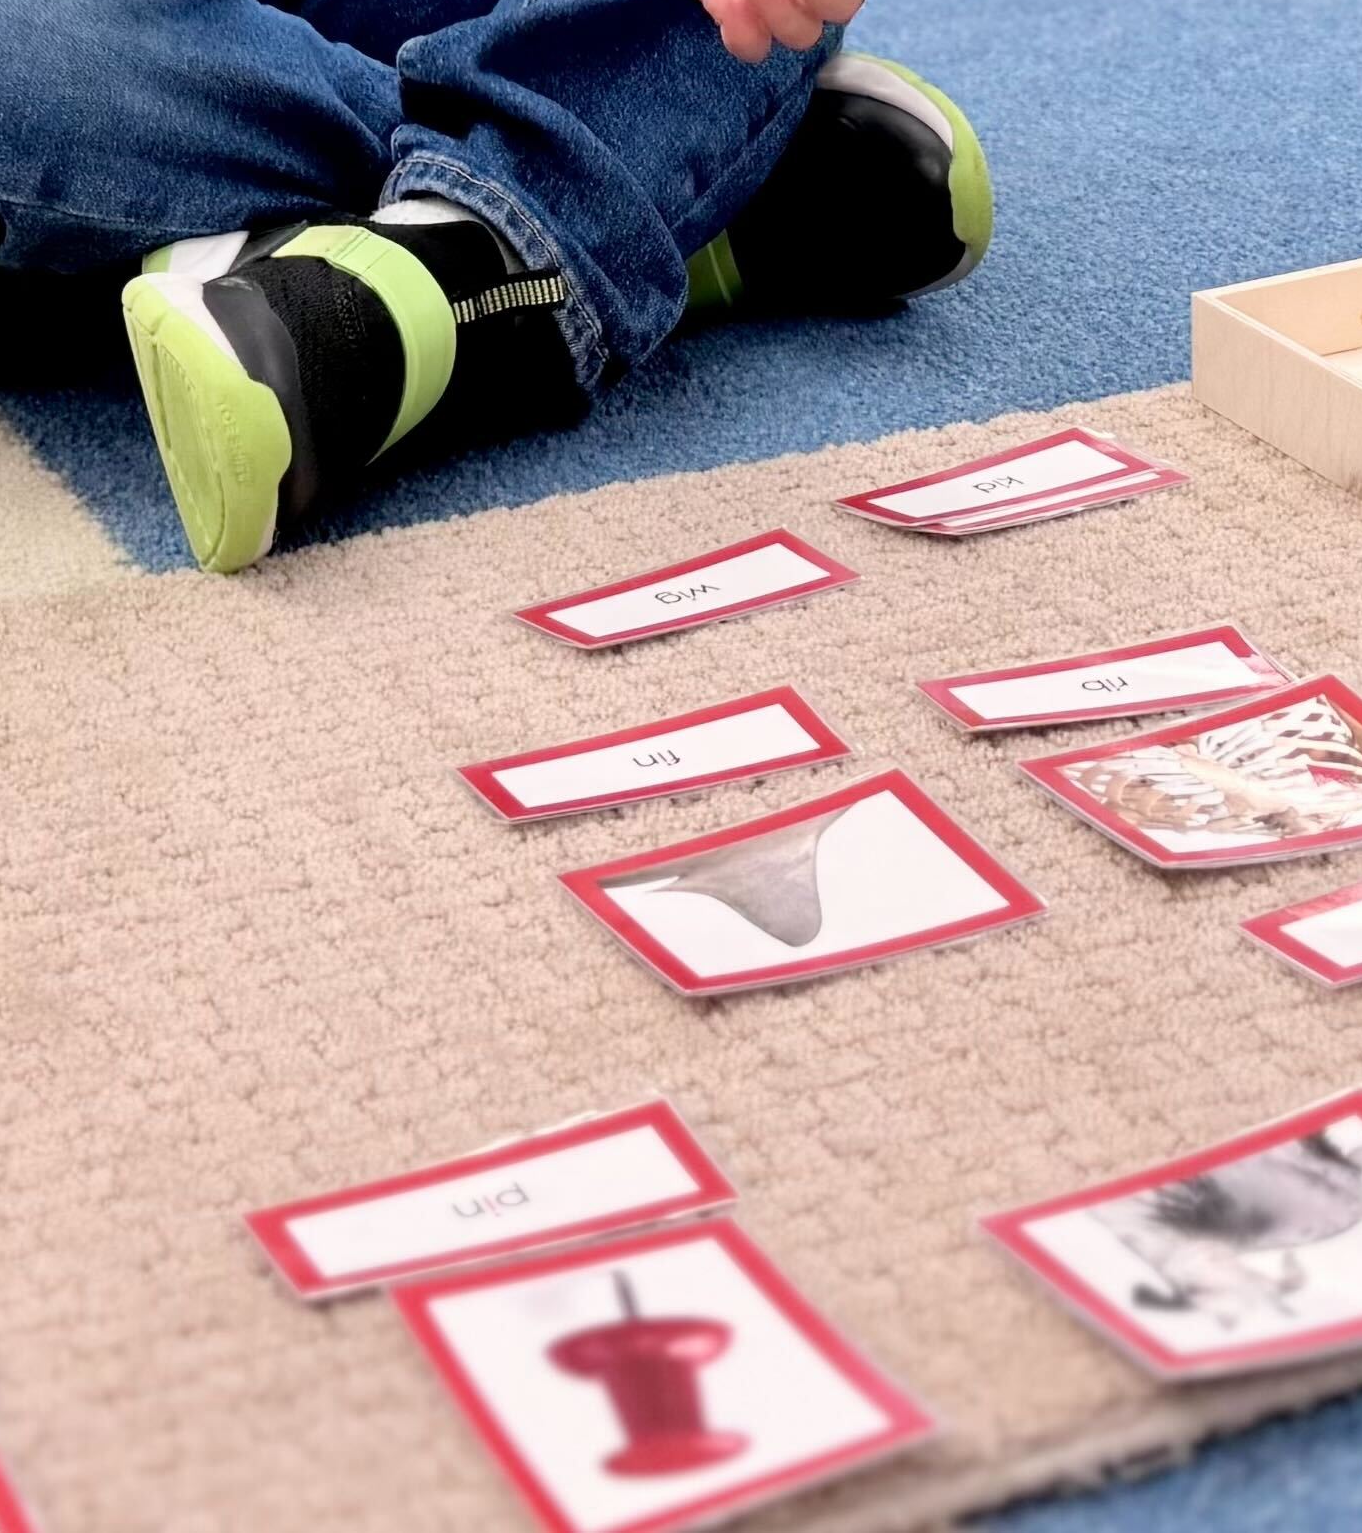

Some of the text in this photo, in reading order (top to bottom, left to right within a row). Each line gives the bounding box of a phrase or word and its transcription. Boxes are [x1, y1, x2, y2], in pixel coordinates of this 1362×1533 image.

[972, 474, 1024, 496] kid
[653, 582, 721, 606] wig
[1080, 676, 1129, 694] rib
[632, 749, 680, 768] fin
[450, 1181, 530, 1219] pin
